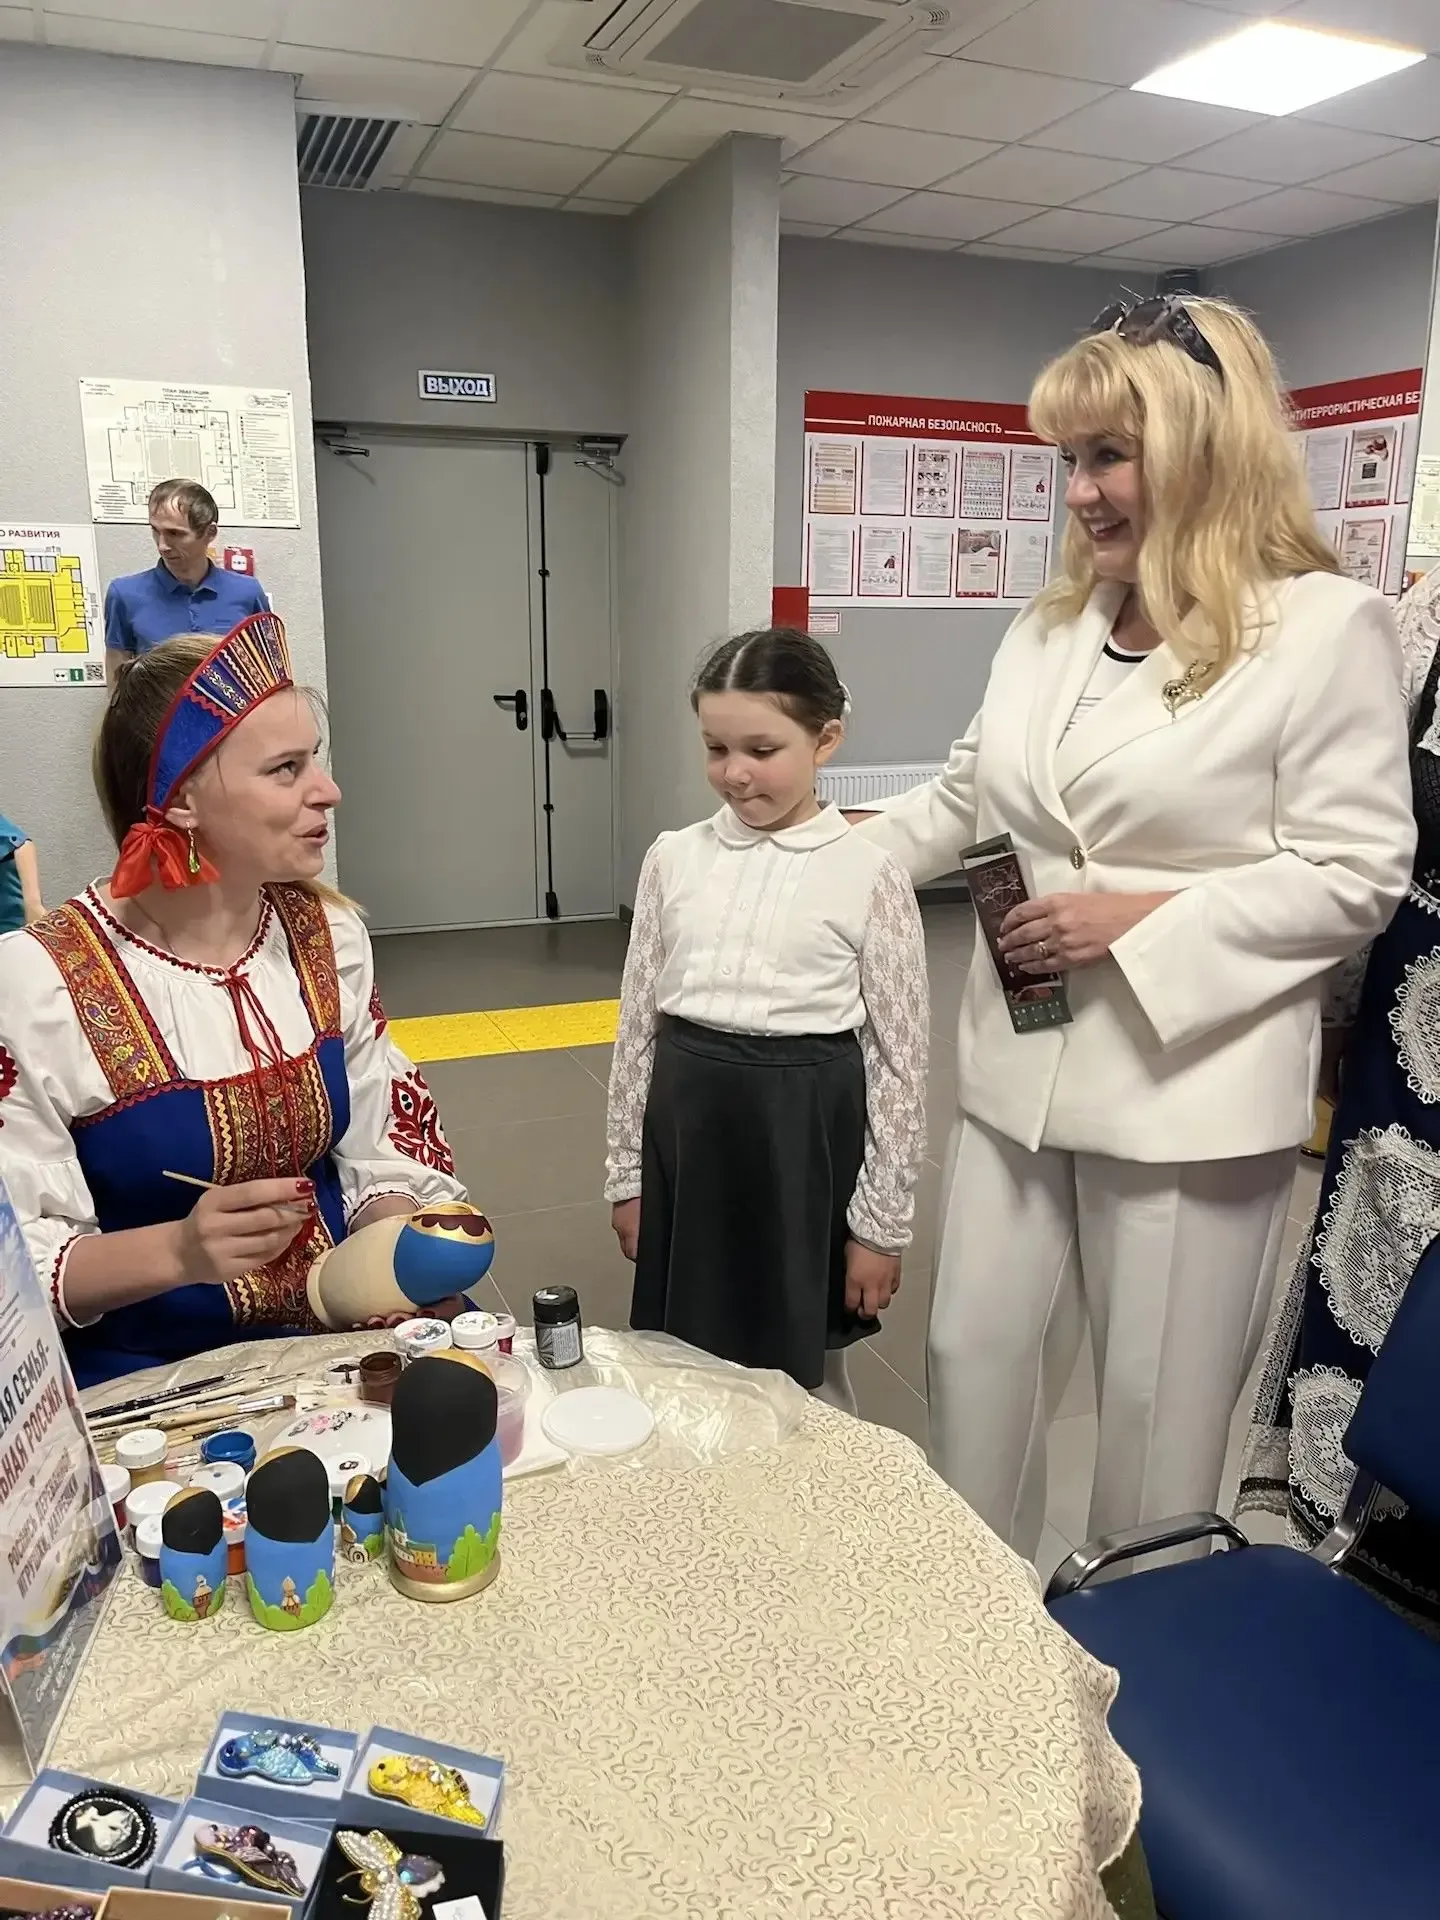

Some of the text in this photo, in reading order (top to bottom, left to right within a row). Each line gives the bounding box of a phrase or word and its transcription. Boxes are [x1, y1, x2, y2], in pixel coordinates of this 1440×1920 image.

[426, 376, 489, 396] ВЫХОД
[1405, 391, 1421, 405] БЕ
[868, 414, 1002, 434] ПОЖАРНАЯ БЕЗОПАСНОСТЬ
[8, 529, 61, 539] РАЗВИТИЯ
[0, 1376, 63, 1504] ЬНАЯ РОССИЯ
